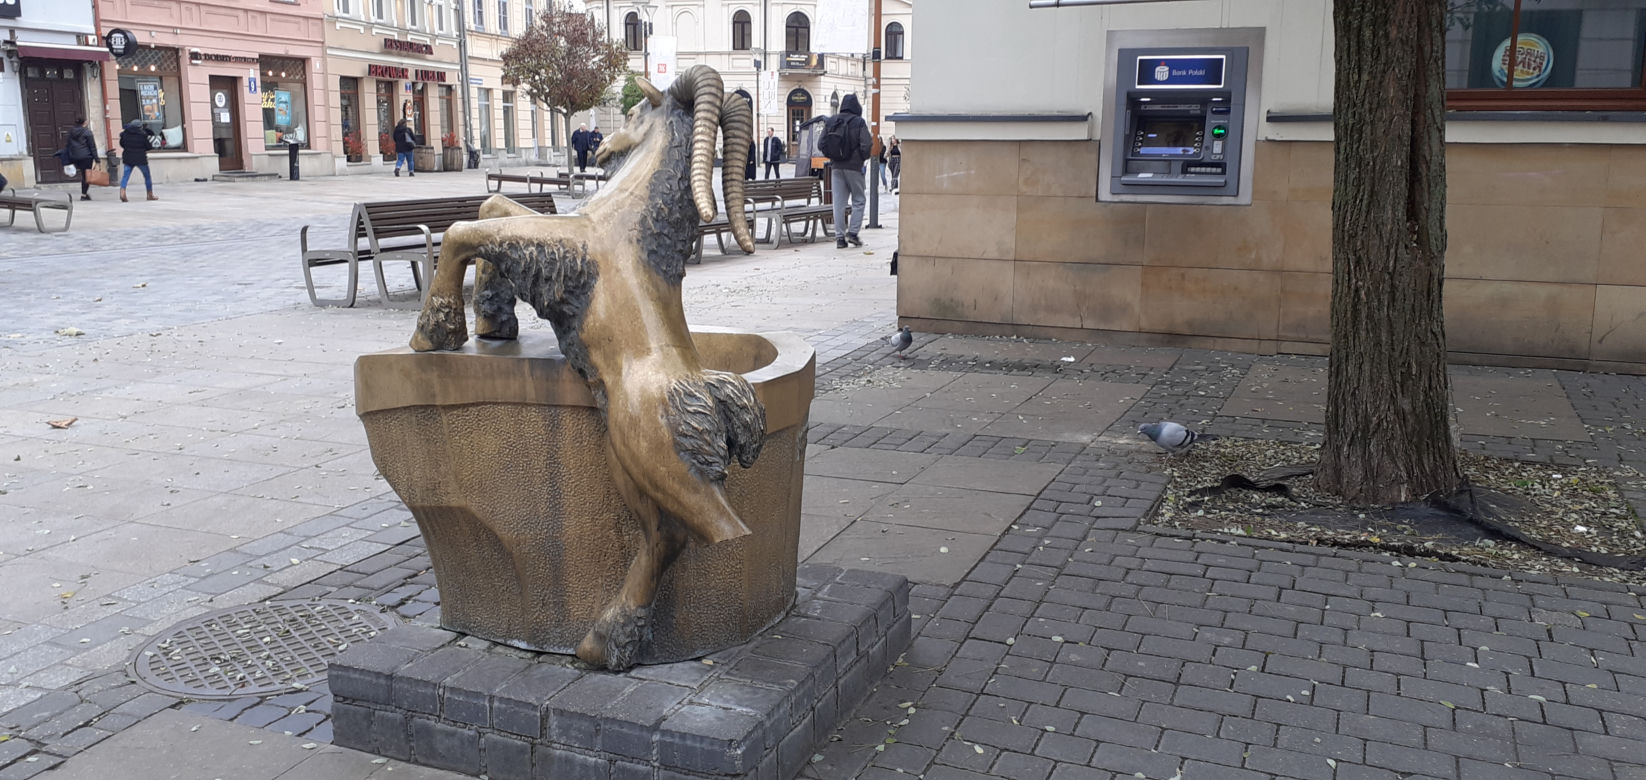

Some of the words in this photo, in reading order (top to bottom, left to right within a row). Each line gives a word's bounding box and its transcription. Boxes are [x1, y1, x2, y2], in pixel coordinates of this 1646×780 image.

[368, 64, 409, 79] BROWAR
[415, 69, 446, 82] LUBLIN
[250, 81, 255, 92] 9
